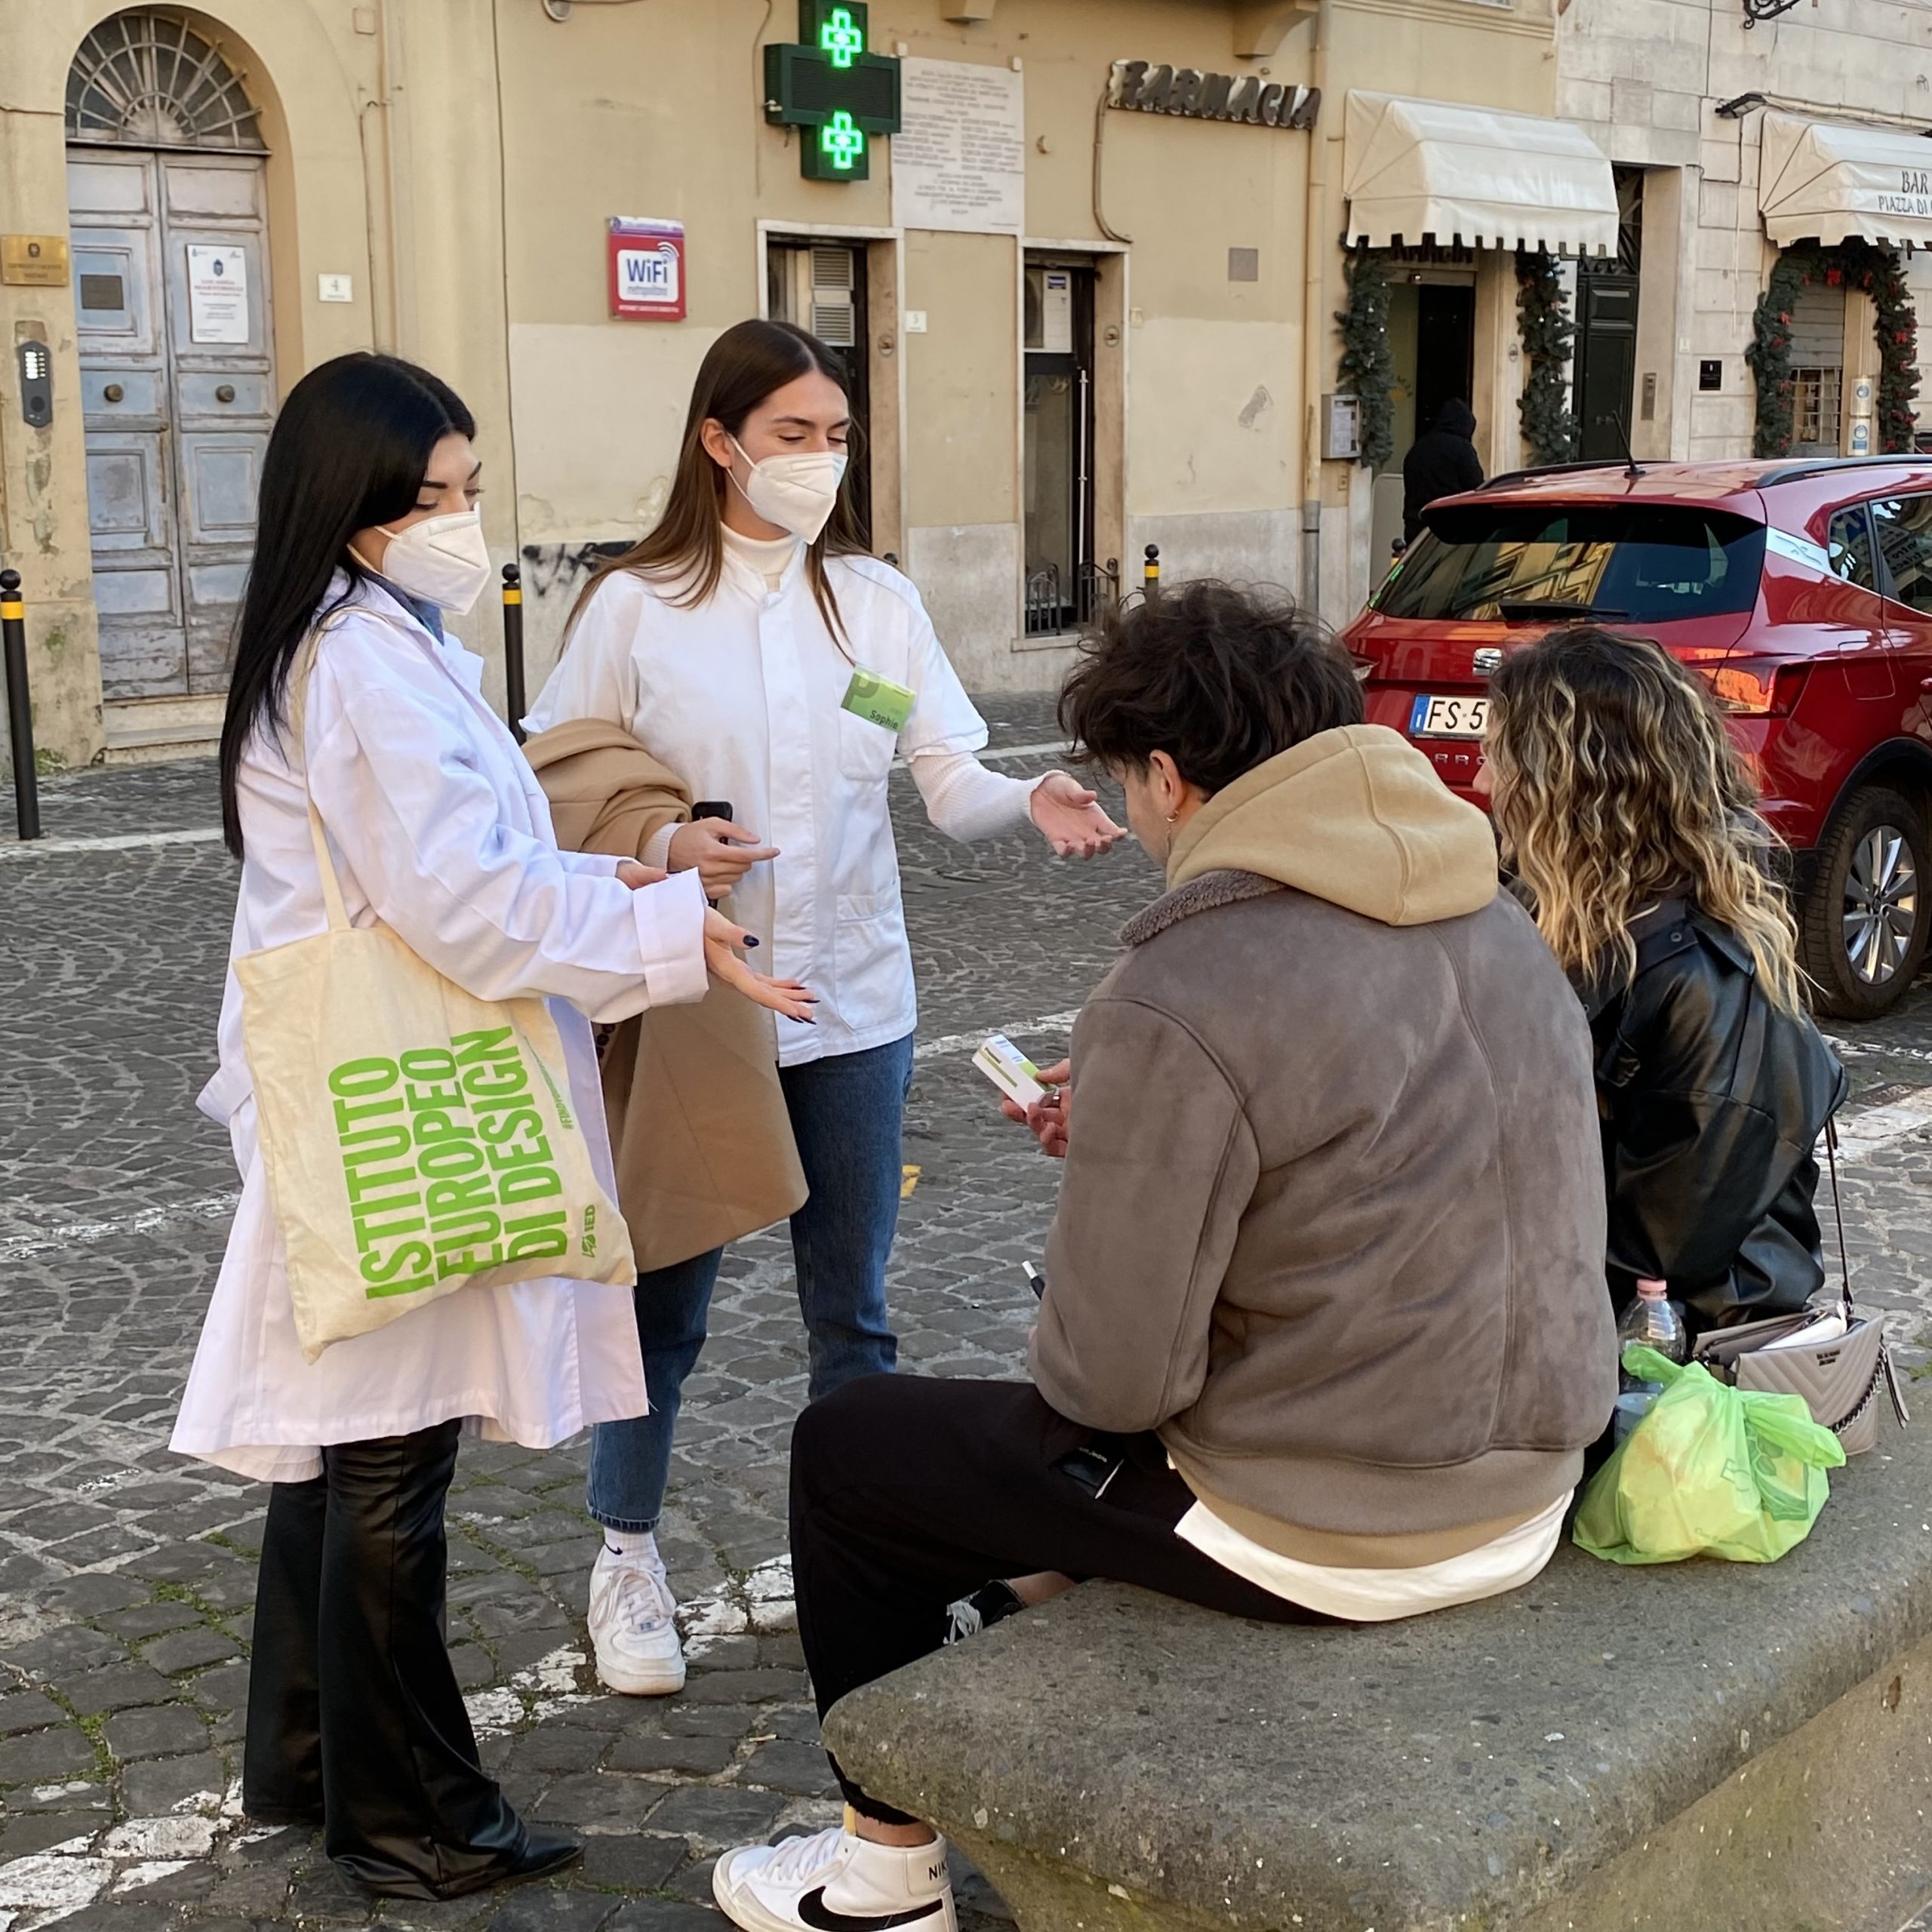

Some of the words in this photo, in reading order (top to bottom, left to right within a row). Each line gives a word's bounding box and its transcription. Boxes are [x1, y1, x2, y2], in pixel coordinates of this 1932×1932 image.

[1901, 171, 1928, 195] BAR
[1878, 195, 1915, 214] PIAZZA
[1917, 198, 1927, 214] DI
[626, 258, 667, 283] WiFi
[869, 709, 899, 730] Sophie
[1427, 700, 1461, 730] FS
[450, 1026, 563, 1207] DESIGN
[328, 1057, 435, 1300] ISTITUTO
[399, 1048, 504, 1281] EUROPEO
[504, 1210, 568, 1264] DI
